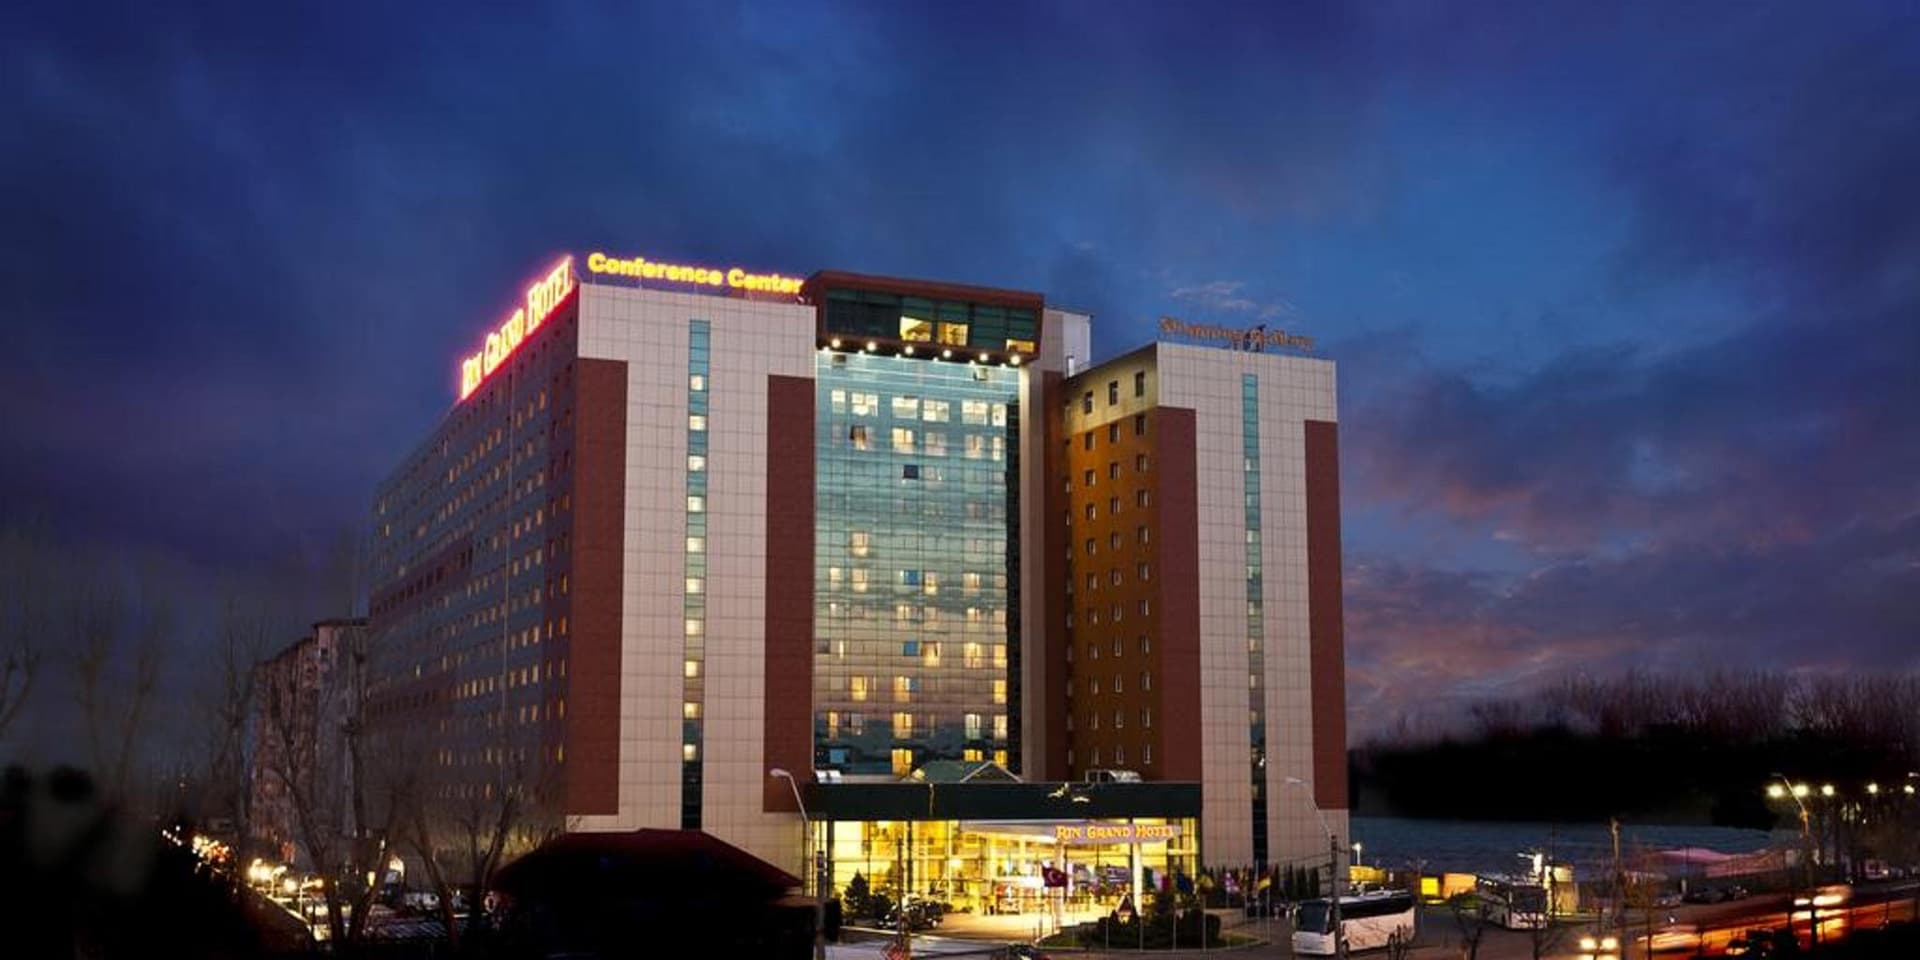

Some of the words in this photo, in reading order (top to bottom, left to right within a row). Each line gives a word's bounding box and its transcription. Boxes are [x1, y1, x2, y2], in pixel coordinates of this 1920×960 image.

[588, 252, 723, 286] Conference
[728, 268, 804, 294] Center
[484, 308, 525, 375] GRAND
[527, 256, 573, 334] HOTEL
[1056, 825, 1081, 840] RIN
[1087, 826, 1131, 839] GRAND
[1136, 825, 1175, 838] HOTEL
